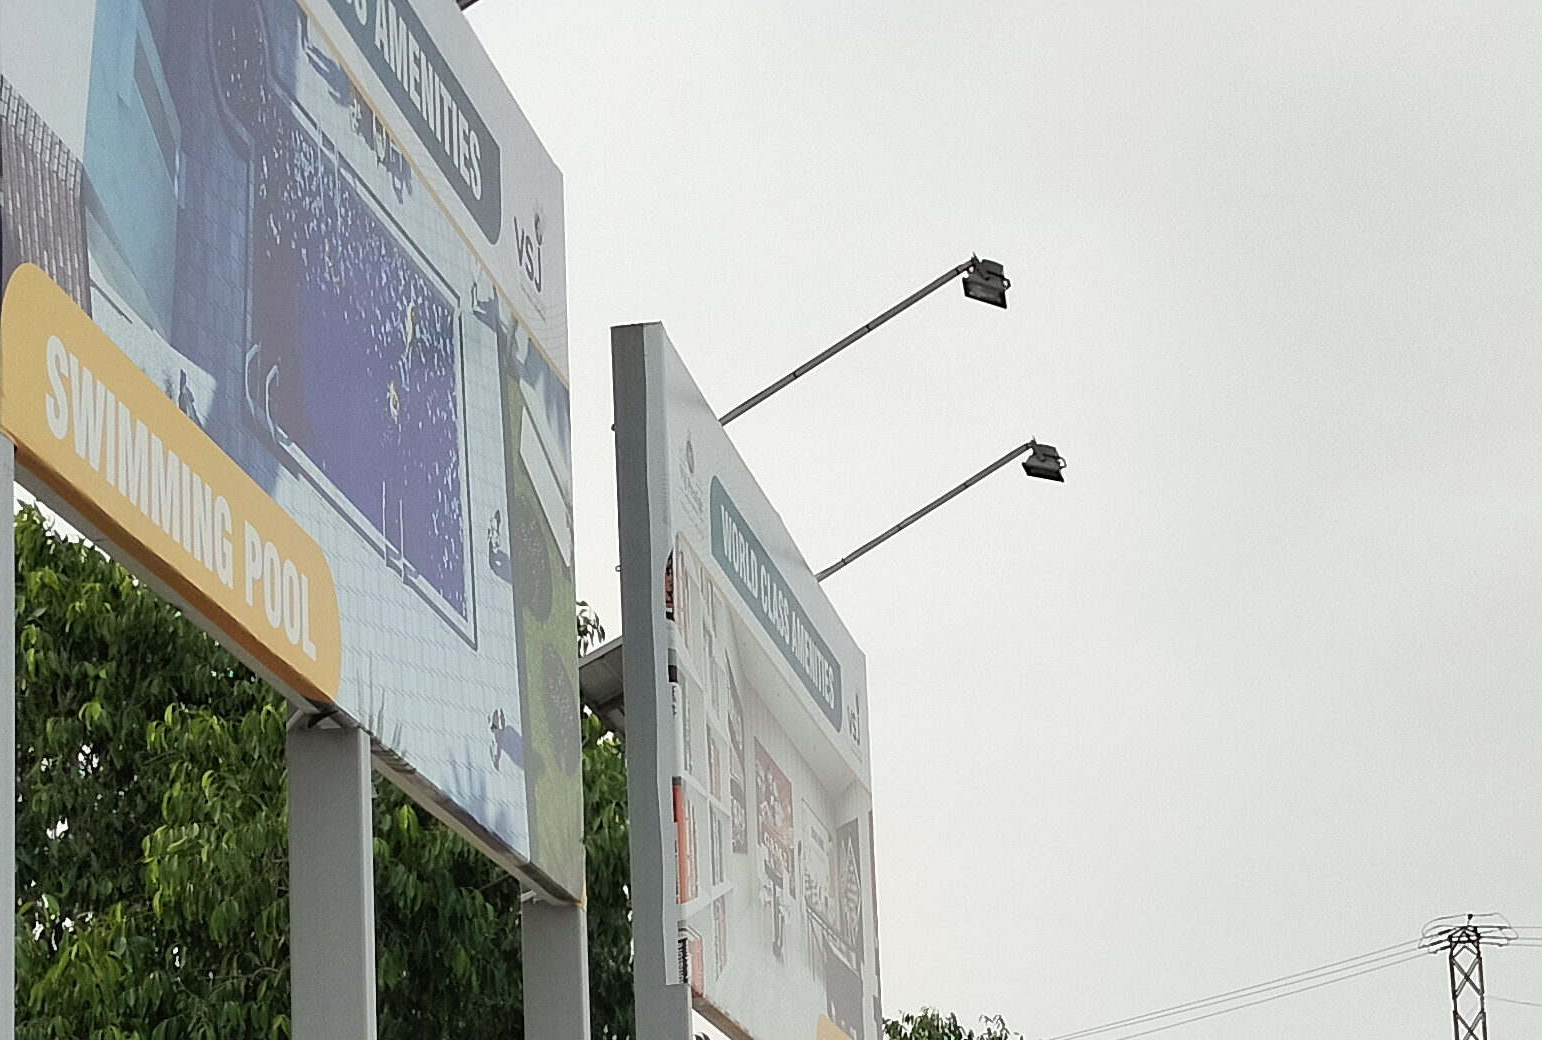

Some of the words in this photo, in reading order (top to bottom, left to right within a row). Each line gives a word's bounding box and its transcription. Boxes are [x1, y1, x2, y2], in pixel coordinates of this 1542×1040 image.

[375, 0, 481, 200] AMENITIES
[46, 335, 234, 590] SWIMMING
[245, 520, 316, 661] POOL
[721, 504, 758, 598] WORLD
[761, 564, 790, 645] CLASS
[792, 610, 834, 709] AMENITIES
